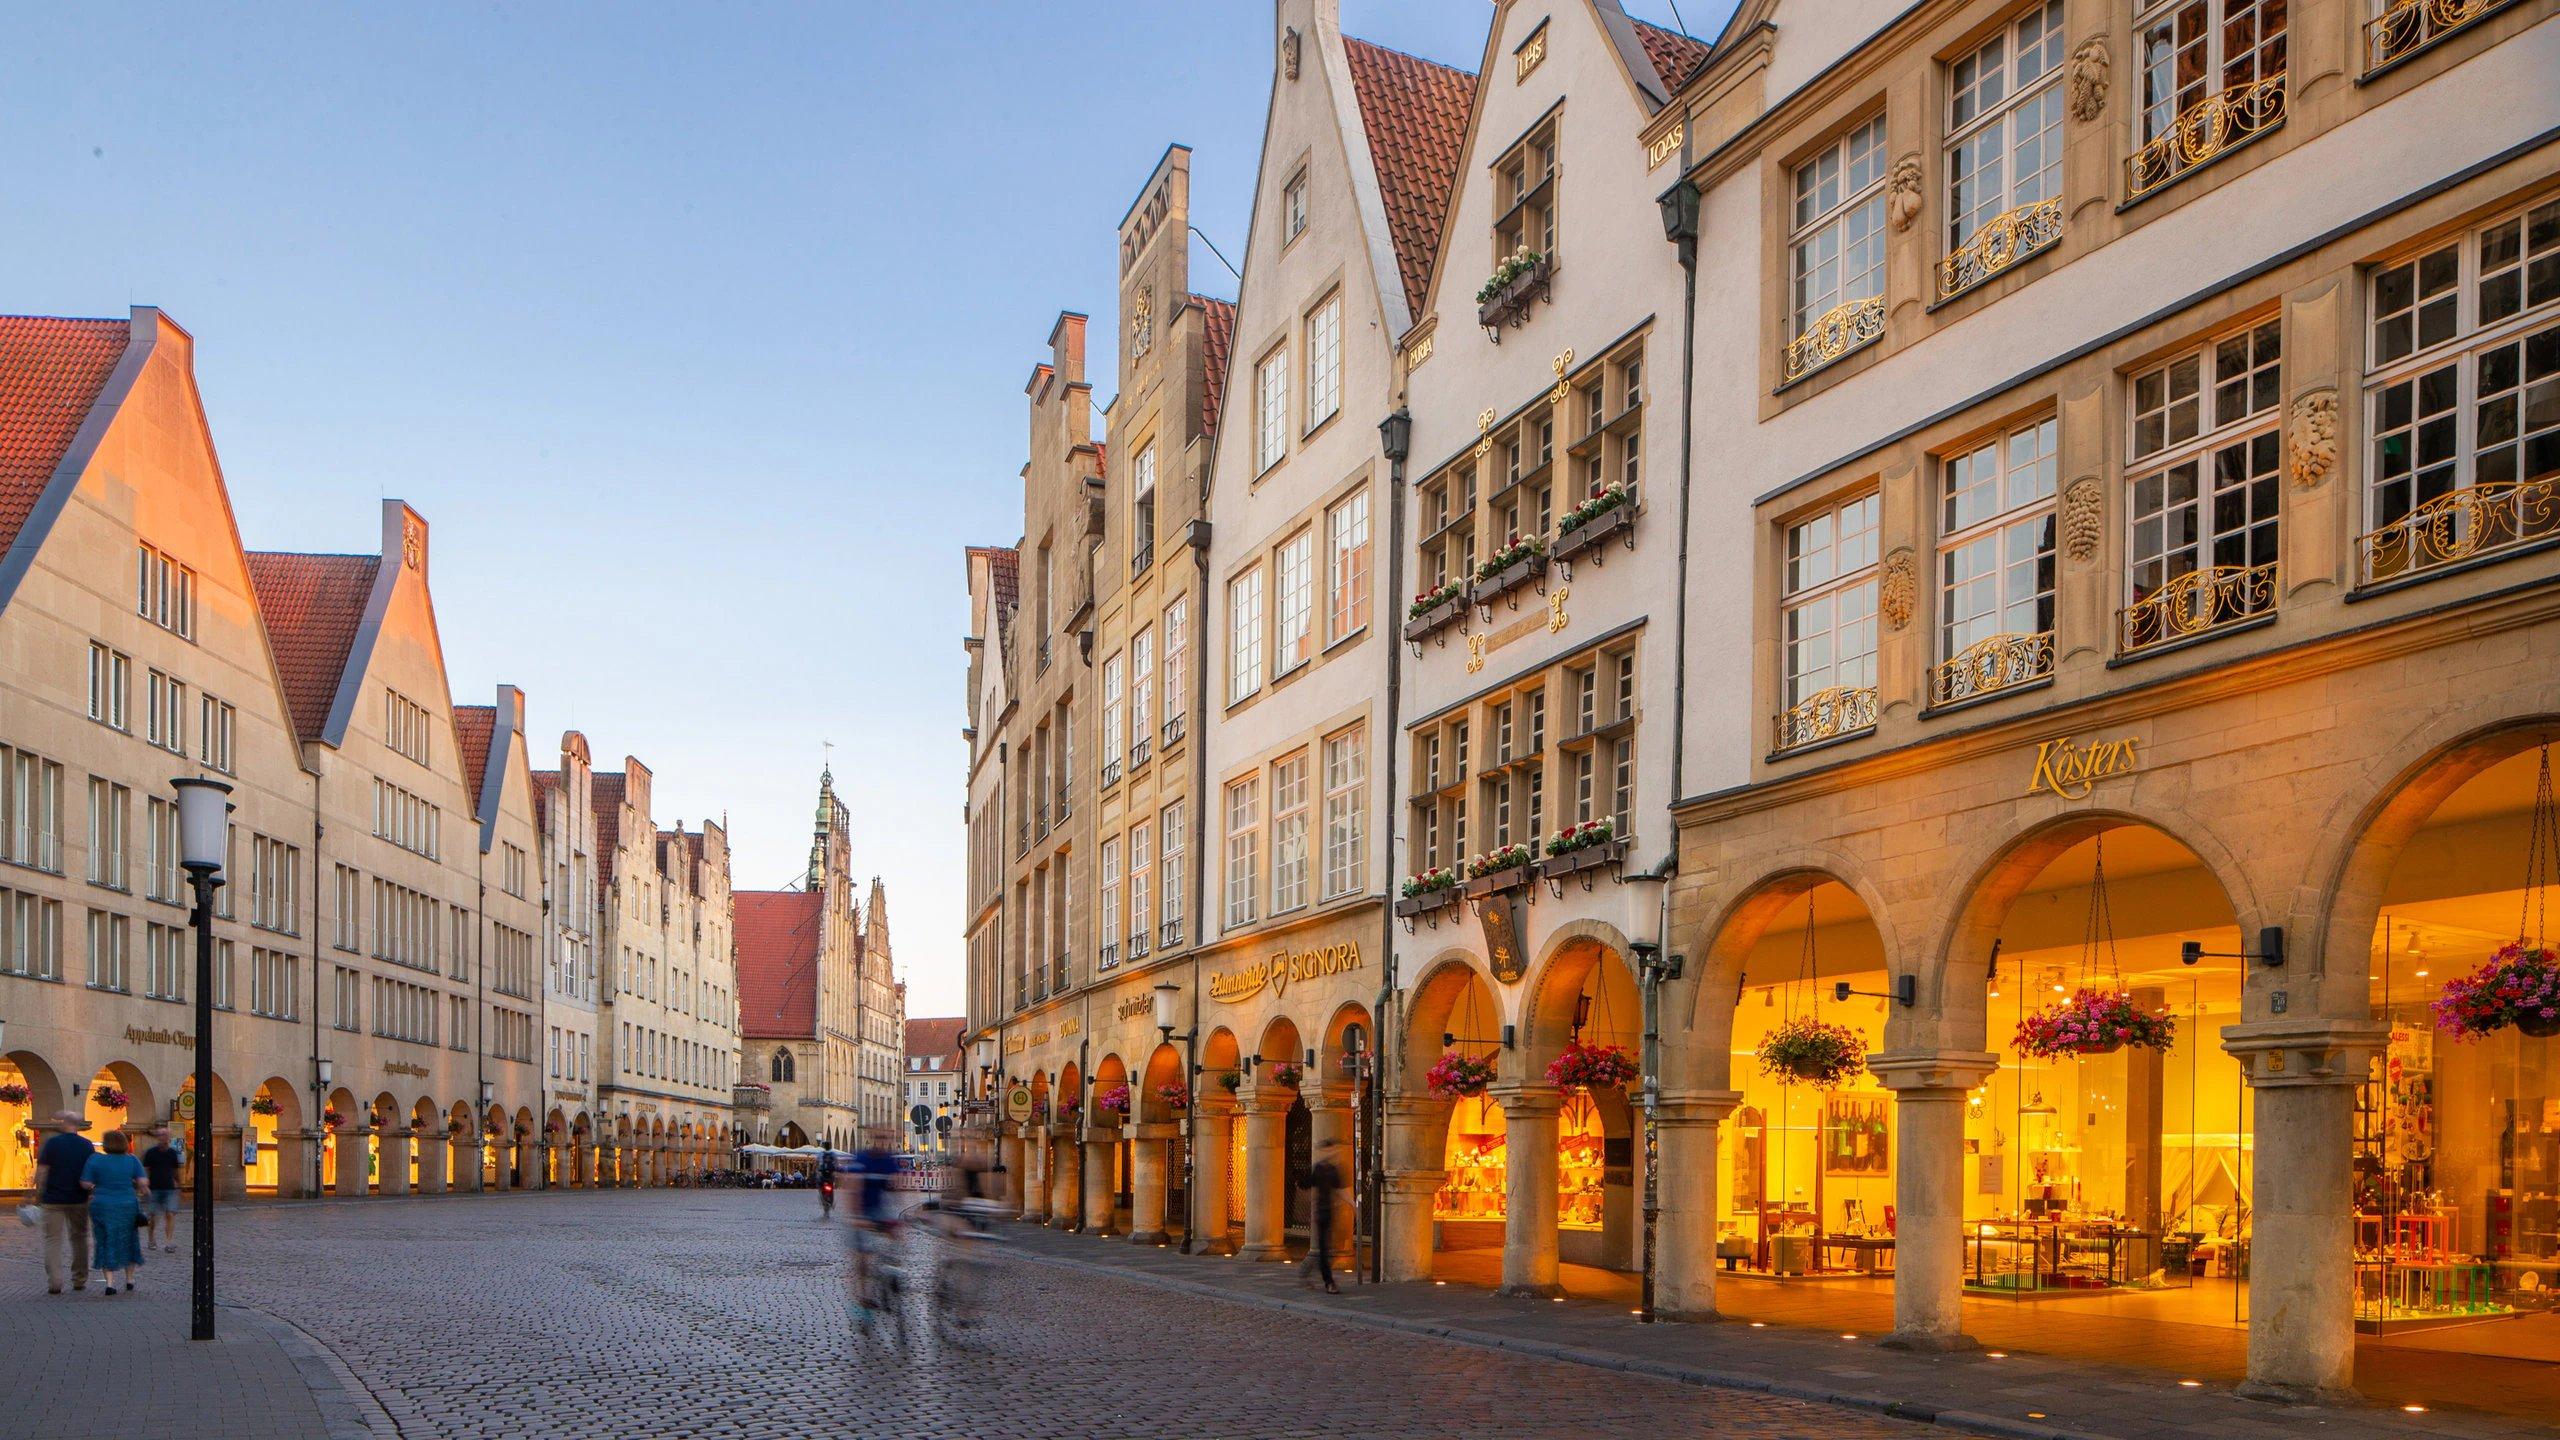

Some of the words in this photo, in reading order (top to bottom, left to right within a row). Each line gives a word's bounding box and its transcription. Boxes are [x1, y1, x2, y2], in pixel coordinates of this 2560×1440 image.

[1649, 123, 1684, 168] IOAS
[2025, 736, 2140, 800] Kösters
[1291, 940, 1363, 982] SIGNORA
